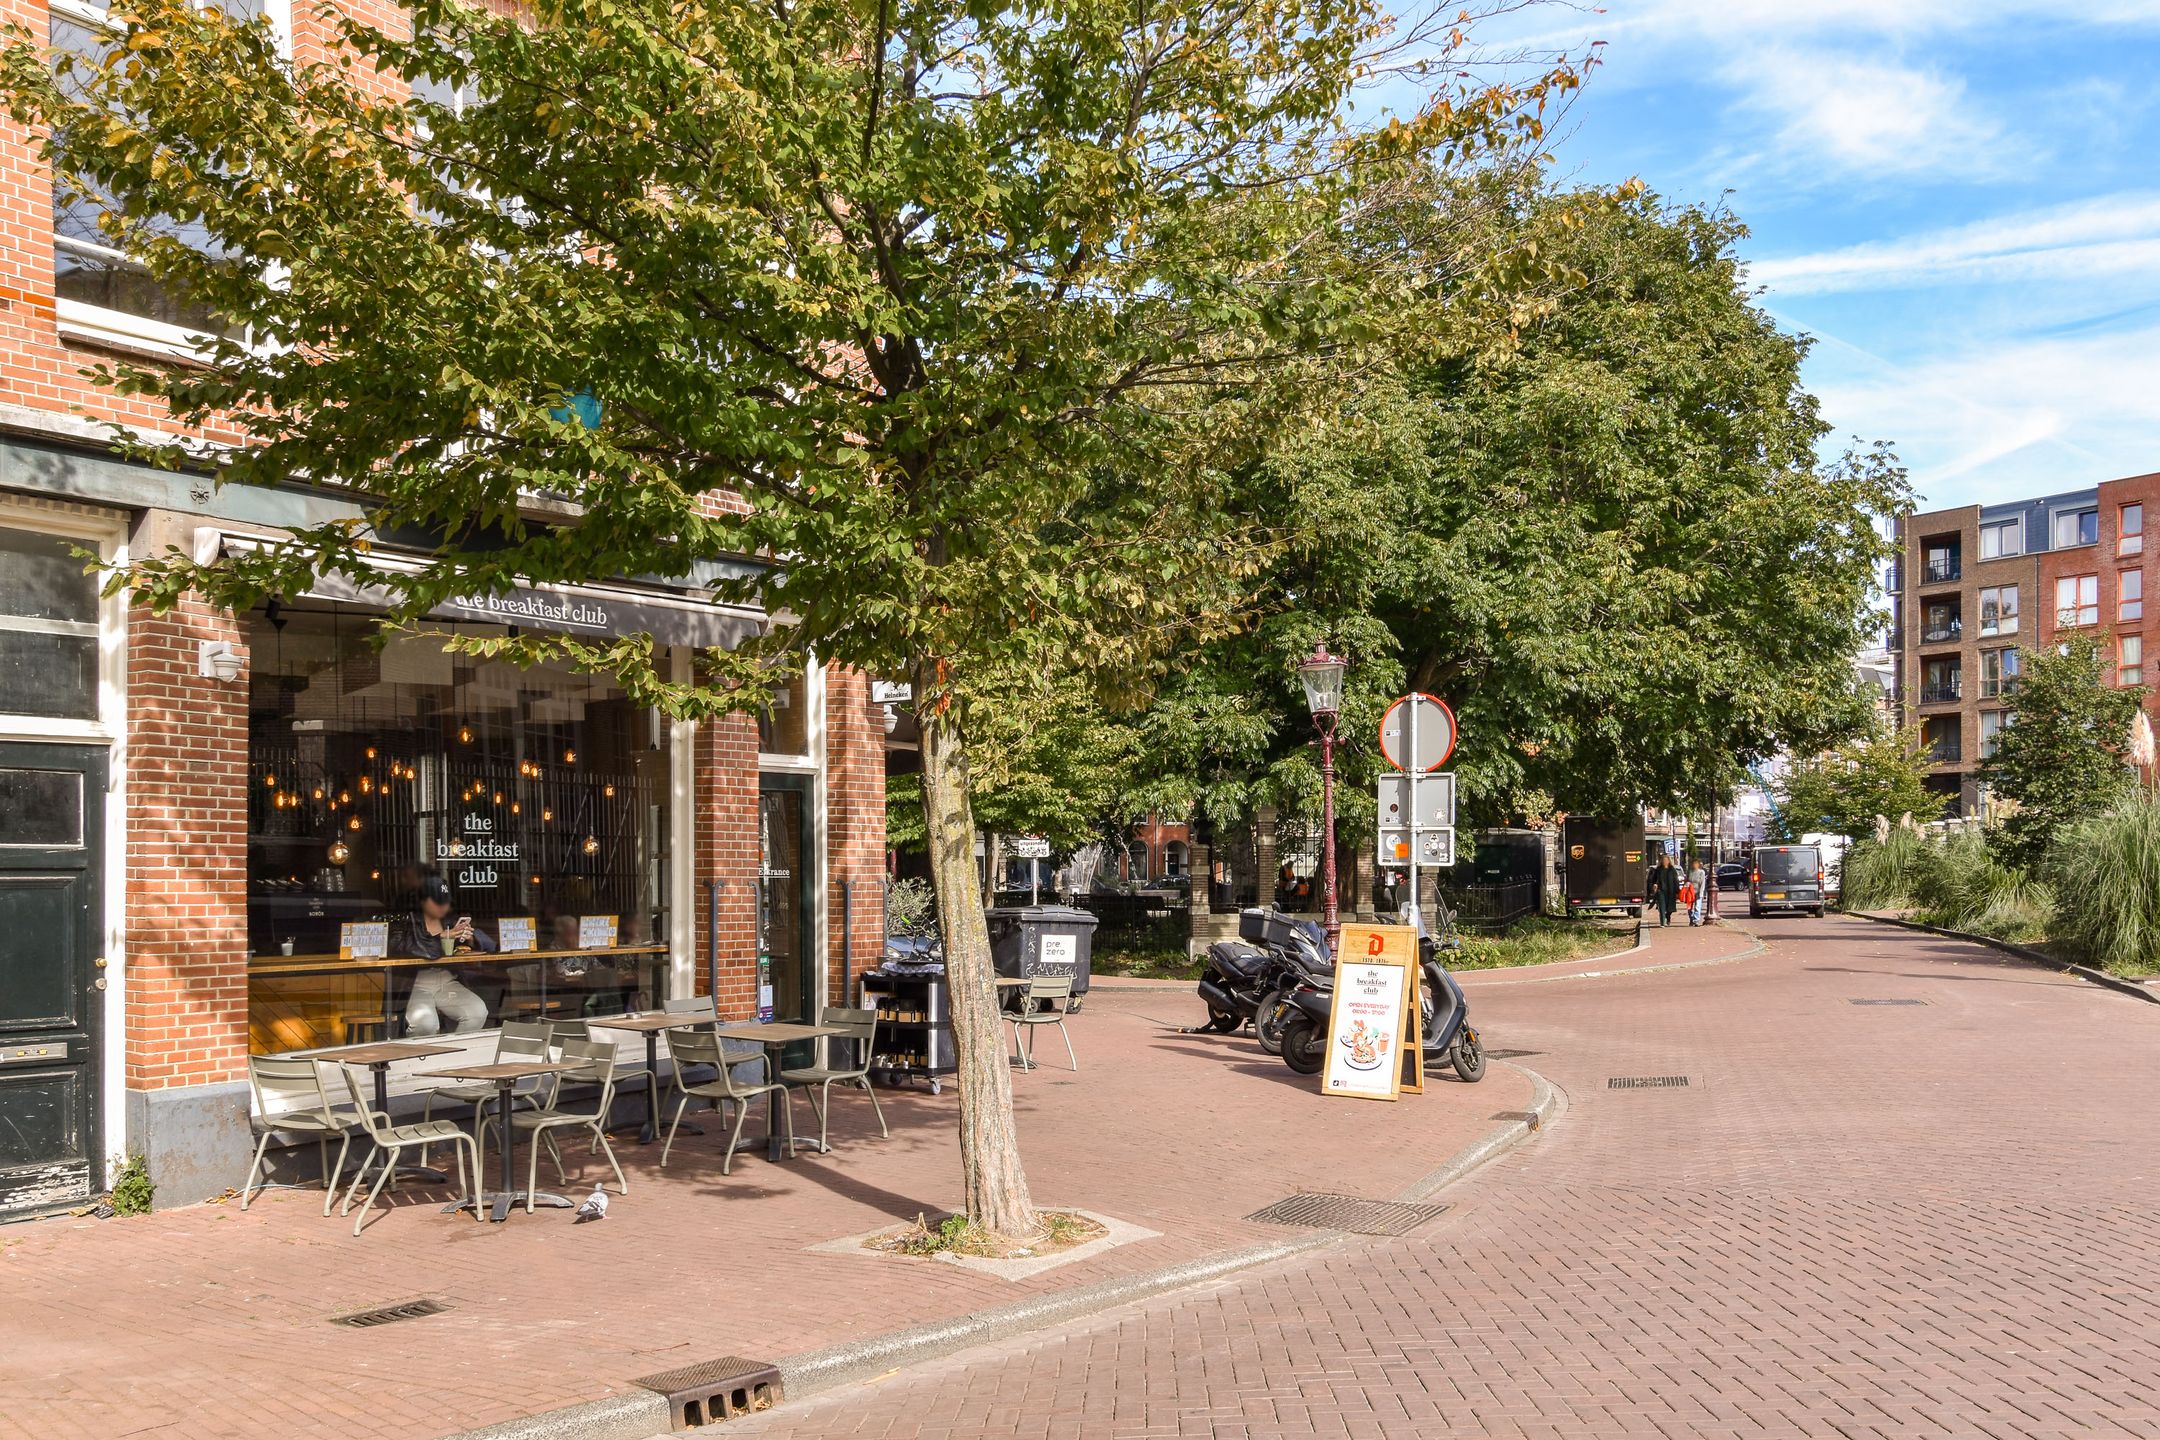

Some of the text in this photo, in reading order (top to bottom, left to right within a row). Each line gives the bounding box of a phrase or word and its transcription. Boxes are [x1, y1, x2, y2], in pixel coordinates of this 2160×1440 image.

[489, 593, 568, 620] breakfast
[572, 604, 607, 625] club
[884, 690, 909, 699] Heineken
[464, 812, 492, 830] the
[436, 839, 519, 857] breakfast
[459, 865, 498, 884] club
[758, 867, 790, 876] Etrance
[1045, 948, 1066, 956] zero
[1356, 977, 1387, 986] breakfast
